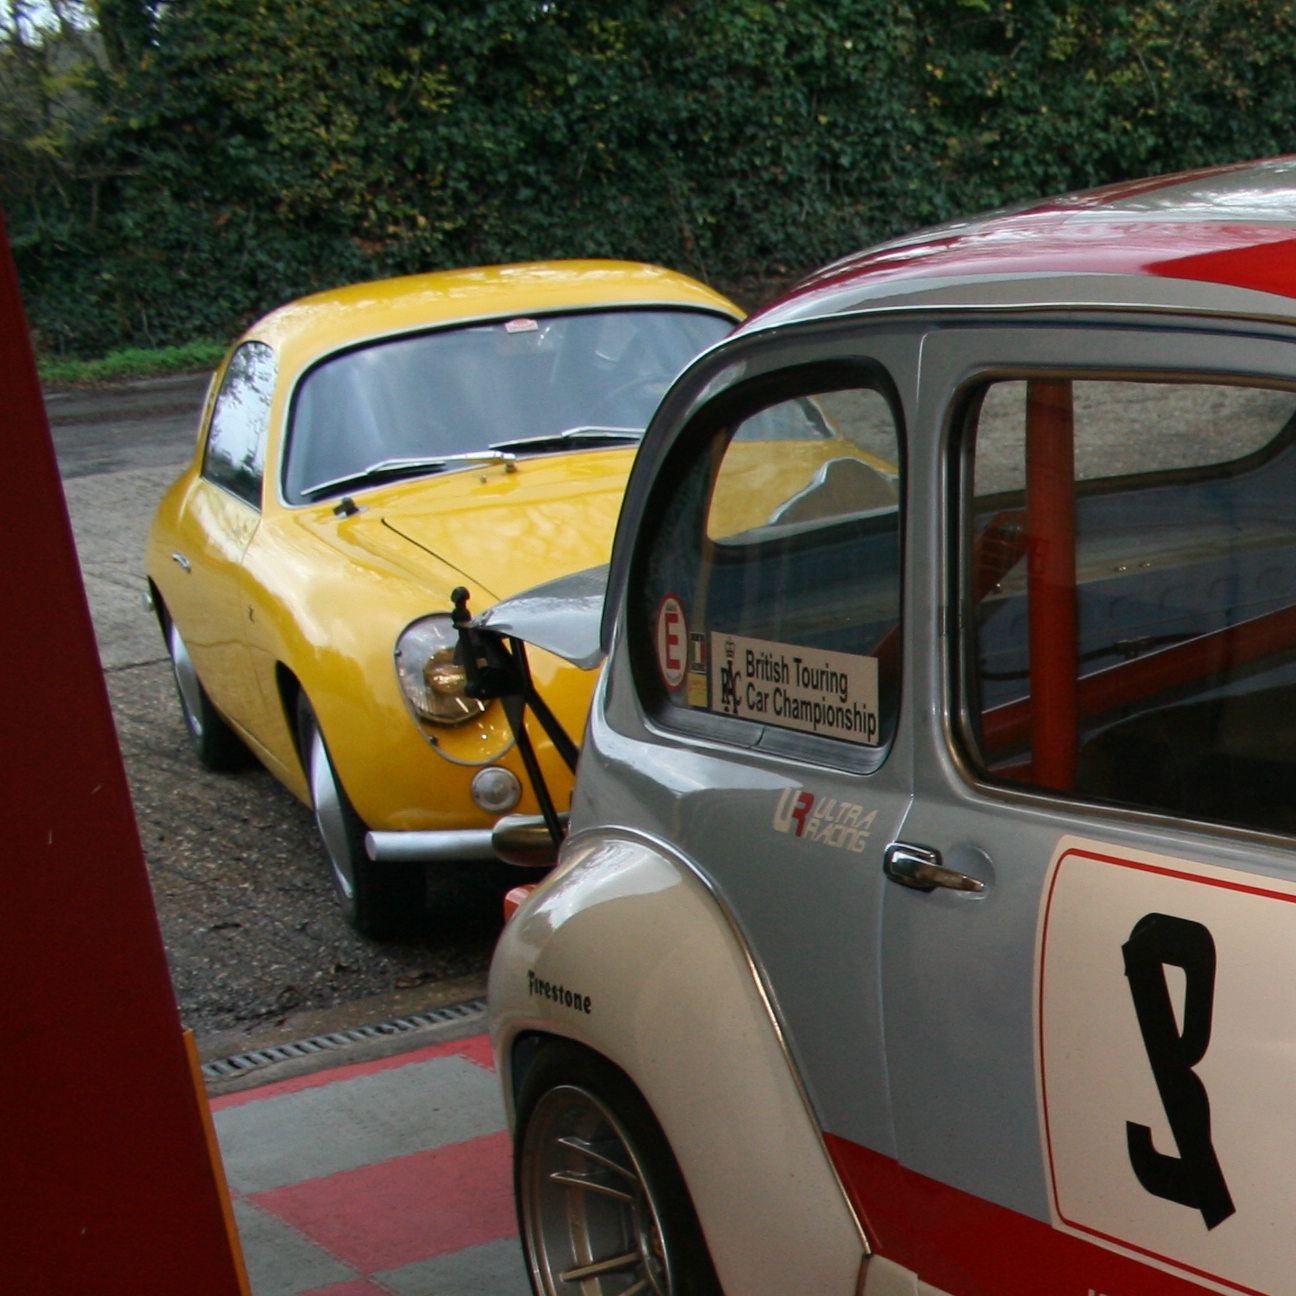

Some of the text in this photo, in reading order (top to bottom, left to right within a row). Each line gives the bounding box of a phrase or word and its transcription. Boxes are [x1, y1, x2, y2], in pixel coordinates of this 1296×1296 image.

[746, 649, 849, 704] British Touring
[746, 682, 769, 714] Car
[773, 687, 877, 742] Championship
[803, 817, 871, 854] RACING
[814, 796, 878, 831] ULTRA
[527, 969, 593, 1015] Firestone
